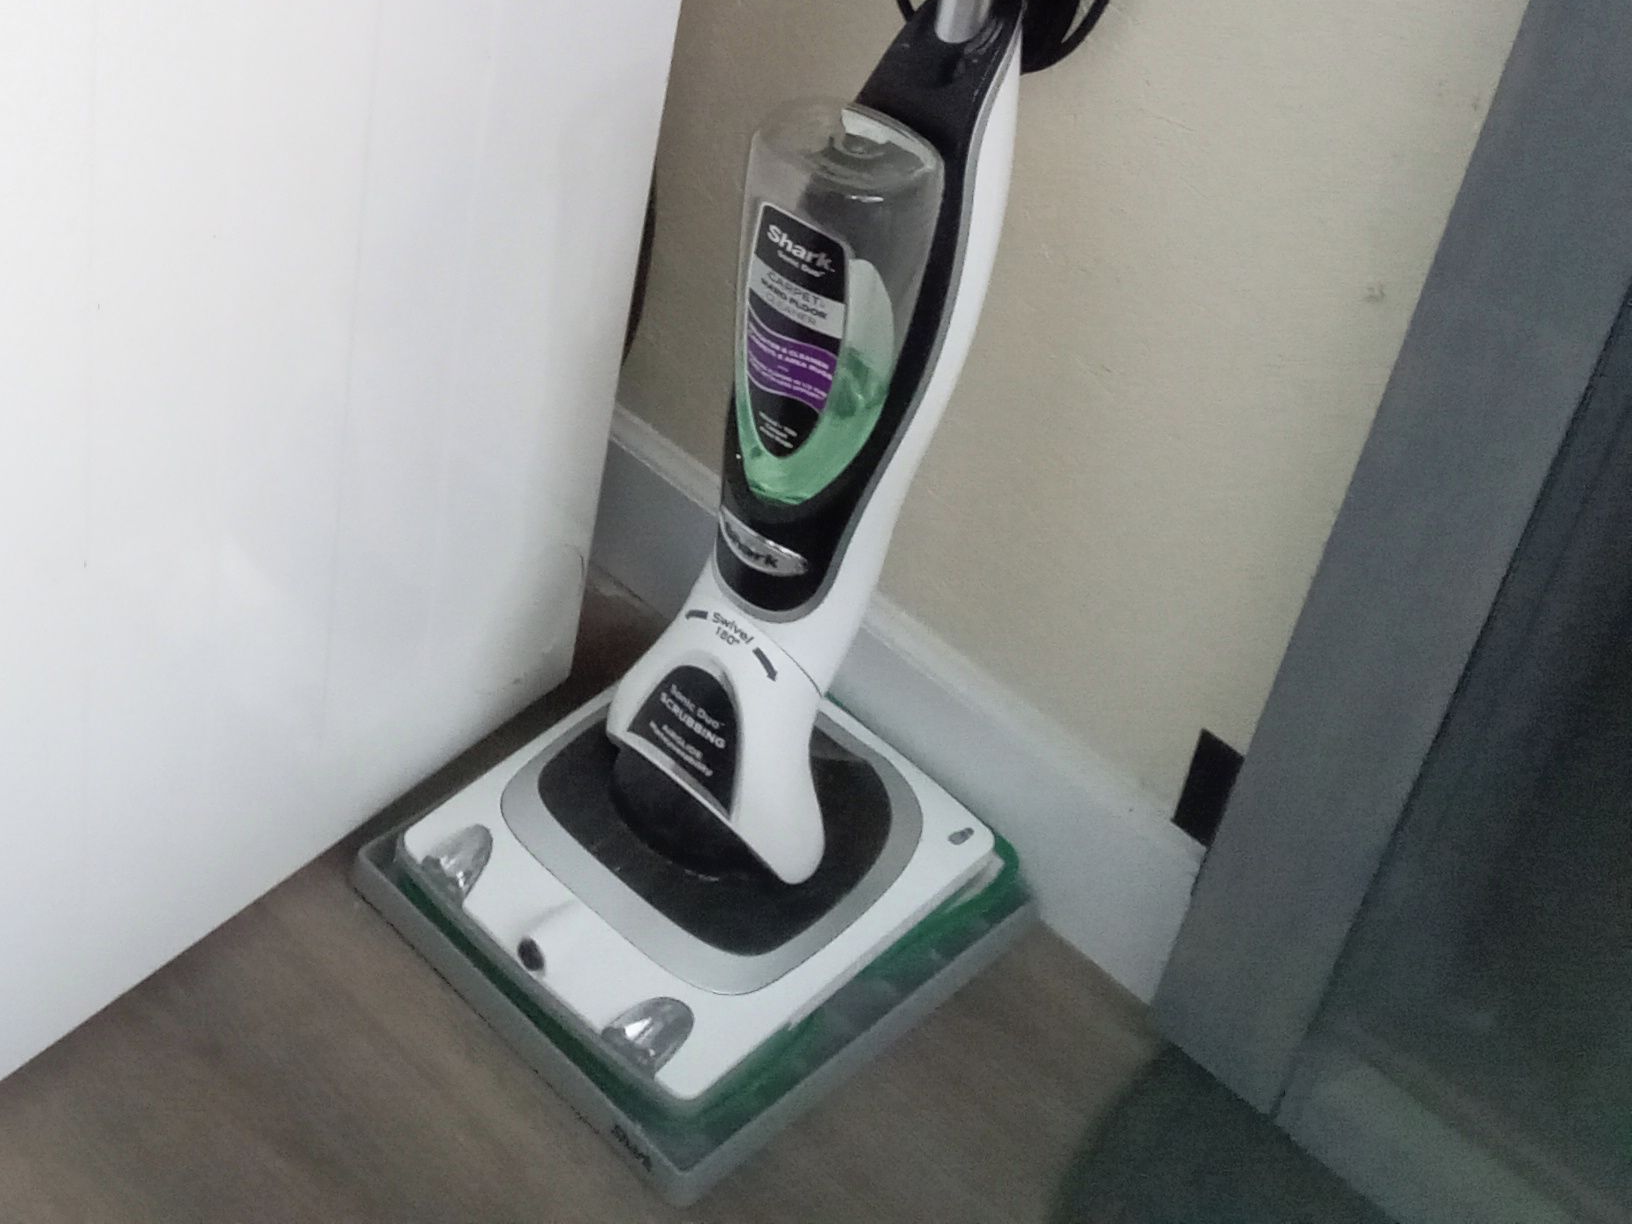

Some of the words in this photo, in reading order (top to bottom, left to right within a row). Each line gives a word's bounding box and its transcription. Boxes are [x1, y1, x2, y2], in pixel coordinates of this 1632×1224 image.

[767, 224, 832, 270] Shark
[767, 271, 820, 304] CARPET
[711, 612, 755, 645] Swivel
[660, 692, 726, 749] SCRUBBING
